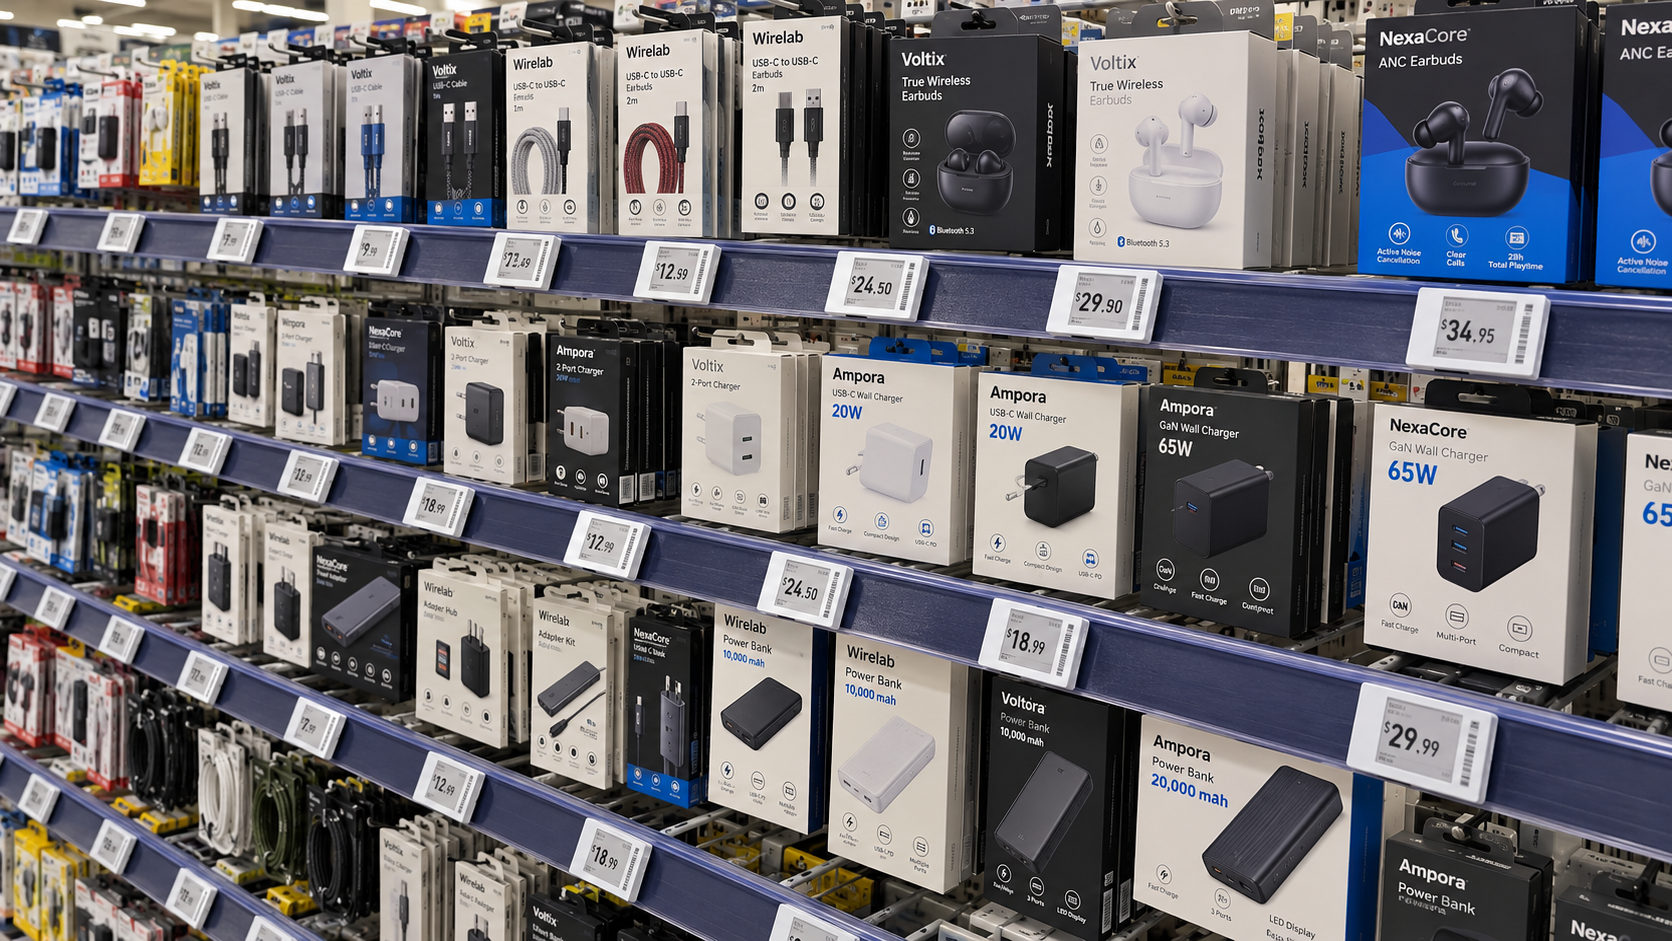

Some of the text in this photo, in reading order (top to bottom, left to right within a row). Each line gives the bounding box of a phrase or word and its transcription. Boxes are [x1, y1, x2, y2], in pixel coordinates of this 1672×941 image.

[753, 30, 803, 45] Wirelab
[1379, 28, 1468, 46] NexaCore
[626, 44, 670, 59] Wirelab
[901, 51, 945, 67] Voltix
[1620, 47, 1652, 60] ANC
[513, 56, 553, 70] Wirelab
[752, 56, 819, 67] USB-C to USB-C
[1090, 55, 1137, 71] Voltix
[1379, 53, 1463, 69] ANC Earbuds
[351, 68, 373, 79] Voltix
[432, 63, 457, 77] Voltix
[626, 69, 683, 80] USB-C to USB-C
[752, 70, 783, 79] Earbuds
[275, 74, 295, 85] Voltix
[902, 75, 971, 87] True Wireless
[1090, 79, 1164, 92] True Wireless
[752, 84, 764, 92] 2m
[902, 90, 943, 101] Earbuds
[626, 97, 638, 105] 2m
[1089, 94, 1132, 106] Earbuds
[965, 227, 974, 235] 5.3
[1126, 238, 1170, 248] Bluetooth 5.3
[851, 275, 893, 295] $24.50
[1075, 292, 1123, 314] $29.90
[1441, 319, 1496, 344] $34.95
[451, 336, 475, 348] Voltix
[556, 344, 594, 359] Ampora
[577, 365, 604, 377] Charger
[691, 358, 724, 373] Voltix
[833, 367, 885, 384] Ampora
[691, 378, 741, 392] 2-Port Charger
[832, 389, 903, 404] USB-C Wall Charger
[990, 385, 1047, 404] Ampora
[832, 403, 863, 420] 20W
[1160, 398, 1214, 417] Ampora
[989, 408, 1067, 424] USB-C Wall Charger
[989, 423, 1023, 441] 20W
[1159, 420, 1240, 440] GaN Wall Charger
[1390, 418, 1467, 439] NexaCore
[1158, 437, 1193, 457] 65W
[1389, 441, 1489, 463] GaN Wall Charger
[1645, 453, 1672, 471] Ne
[1388, 460, 1438, 485] 65W
[1643, 479, 1671, 493] GaN
[421, 496, 446, 515] $18.99
[424, 581, 453, 598] Wirelab
[782, 576, 818, 601] $24.50
[1191, 591, 1204, 600] Fast
[724, 613, 767, 635] Wirelab
[1381, 619, 1419, 634] Fast Charge
[565, 635, 576, 647] Kit
[633, 627, 670, 646] NexaCore
[723, 634, 773, 655] Power Bank
[1006, 628, 1046, 655] $18.99
[1436, 631, 1477, 646] Multi-Port
[723, 649, 748, 664] 10,000
[847, 644, 895, 668] Wirelab
[1499, 643, 1540, 659] Compact
[845, 667, 903, 690] Power Bank
[1638, 675, 1655, 686] Fast
[844, 683, 876, 700] 10,000
[1001, 691, 1045, 715] Voltora
[1000, 712, 1050, 734] Power Bank
[1000, 726, 1026, 742] 10,000
[1383, 720, 1440, 758] $29.99
[1153, 734, 1211, 763] Ampora
[1152, 756, 1214, 784] Power Bank
[1151, 773, 1196, 798] 20,000
[591, 845, 618, 871] $18.99
[459, 872, 485, 893] Wirelab
[1398, 858, 1467, 891] Ampora
[1398, 882, 1438, 904] Power
[1440, 895, 1476, 917] Bank
[532, 905, 558, 927] Voltix
[1269, 914, 1285, 927] LED
[1285, 921, 1316, 940] Display
